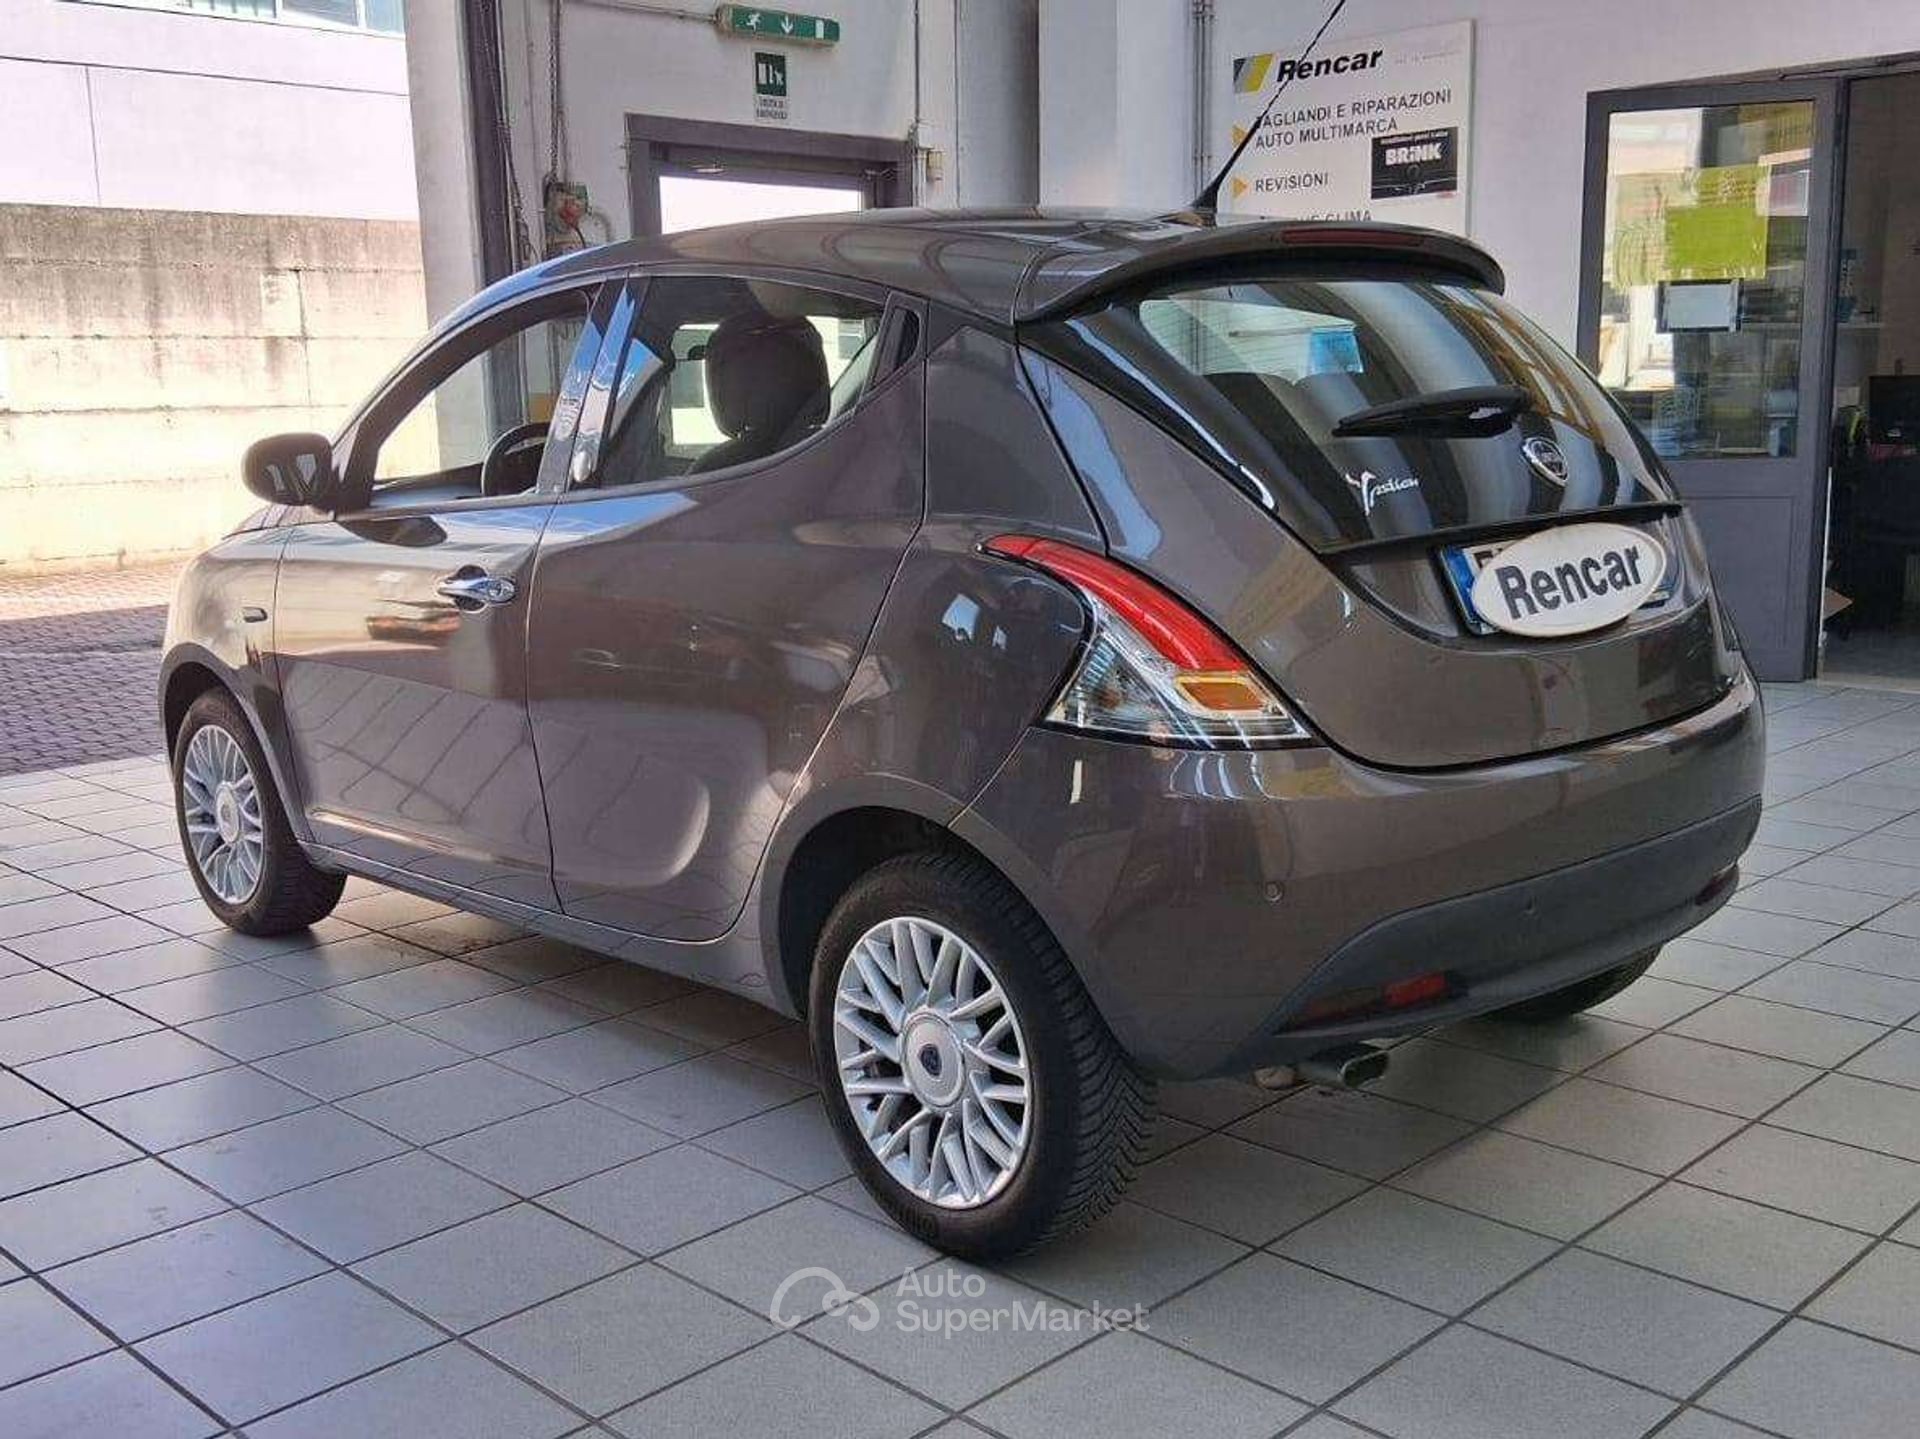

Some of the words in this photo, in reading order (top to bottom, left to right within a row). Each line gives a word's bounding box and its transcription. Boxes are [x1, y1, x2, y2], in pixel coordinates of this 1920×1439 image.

[1277, 50, 1383, 82] Rencar
[1336, 103, 1346, 118] E
[1351, 89, 1451, 115] RIPARAZIONI
[1256, 131, 1294, 149] AUTO
[1299, 117, 1398, 143] MULTIMARCA
[1255, 172, 1329, 192] REVISIONI
[1494, 545, 1641, 620] Rencar
